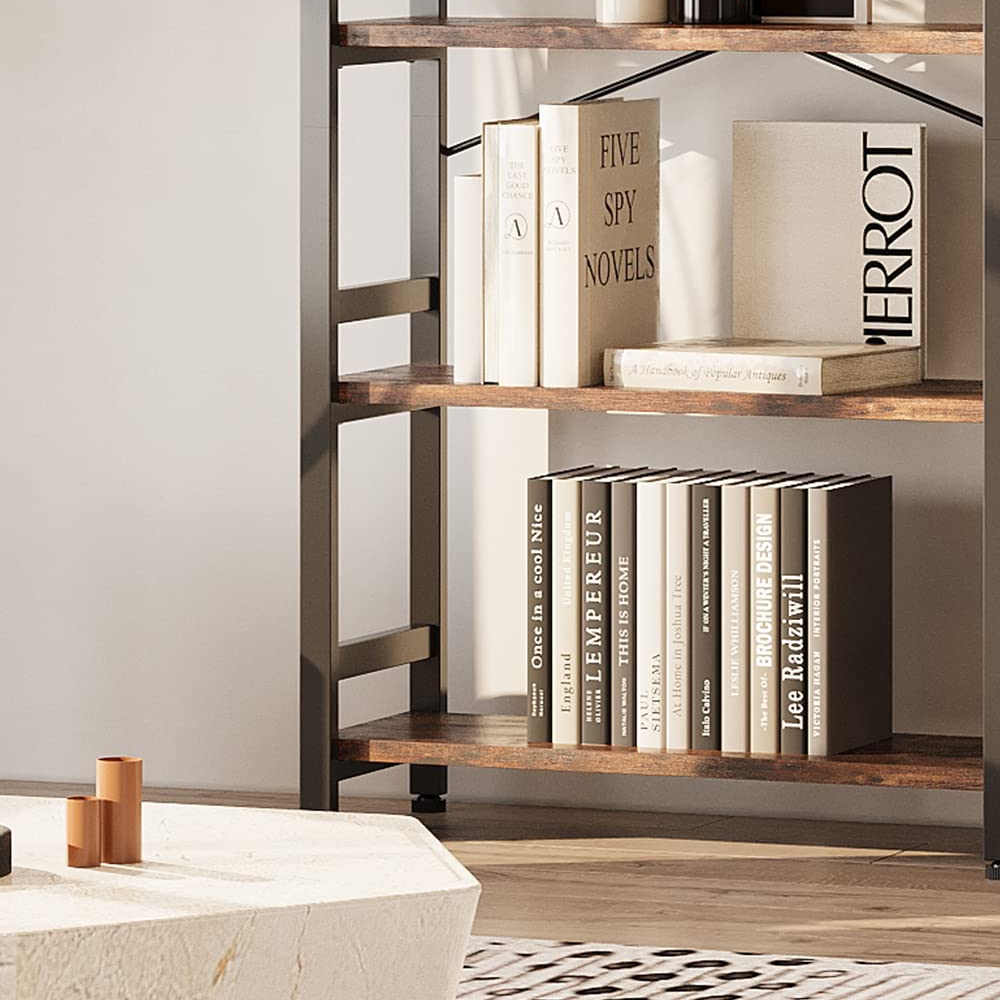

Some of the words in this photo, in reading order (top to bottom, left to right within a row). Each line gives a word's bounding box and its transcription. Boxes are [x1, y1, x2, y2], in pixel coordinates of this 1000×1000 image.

[599, 131, 641, 169] FIVE
[603, 189, 638, 227] SPY
[862, 131, 914, 346] IERROT
[584, 245, 656, 289] NOVELS
[742, 367, 788, 384] Antiques
[531, 503, 543, 543] Nice
[702, 498, 710, 540] TRAVELLER
[702, 539, 710, 547] A
[702, 546, 710, 570] NIGHT
[755, 513, 773, 574] DESIGN
[531, 548, 543, 585] cool
[618, 555, 629, 606] HOME
[812, 538, 821, 590] PORTRAITS
[534, 590, 543, 599] a
[585, 509, 603, 683] LEMPEREUR
[672, 574, 682, 600] Tree
[702, 570, 710, 606] WINTER'S
[531, 604, 543, 621] in
[618, 609, 629, 626] IS
[672, 604, 685, 646] Joshua
[702, 613, 710, 624] ON
[702, 625, 710, 633] IF
[755, 577, 773, 668] BROCHURE
[781, 573, 804, 681] Radziwill
[812, 593, 821, 638] INTERIOR
[531, 625, 543, 669] Once
[618, 628, 629, 667] THIS
[672, 648, 682, 660] in
[560, 653, 574, 713] England
[672, 664, 682, 698] Home
[730, 658, 740, 697] LESLIE
[812, 650, 821, 686] HAGAN
[585, 689, 593, 723] HELENE
[594, 688, 602, 724] OLIVIER
[620, 677, 628, 707] WALTON
[639, 689, 650, 732] PAUL
[650, 652, 661, 733] SIETSEMA
[672, 702, 682, 718] At
[701, 679, 711, 715] Calvino
[760, 690, 769, 709] Best
[781, 690, 804, 730] Lee
[620, 707, 628, 737] NATALIE
[701, 716, 711, 737] Italo
[812, 688, 821, 737] VICTORIA
